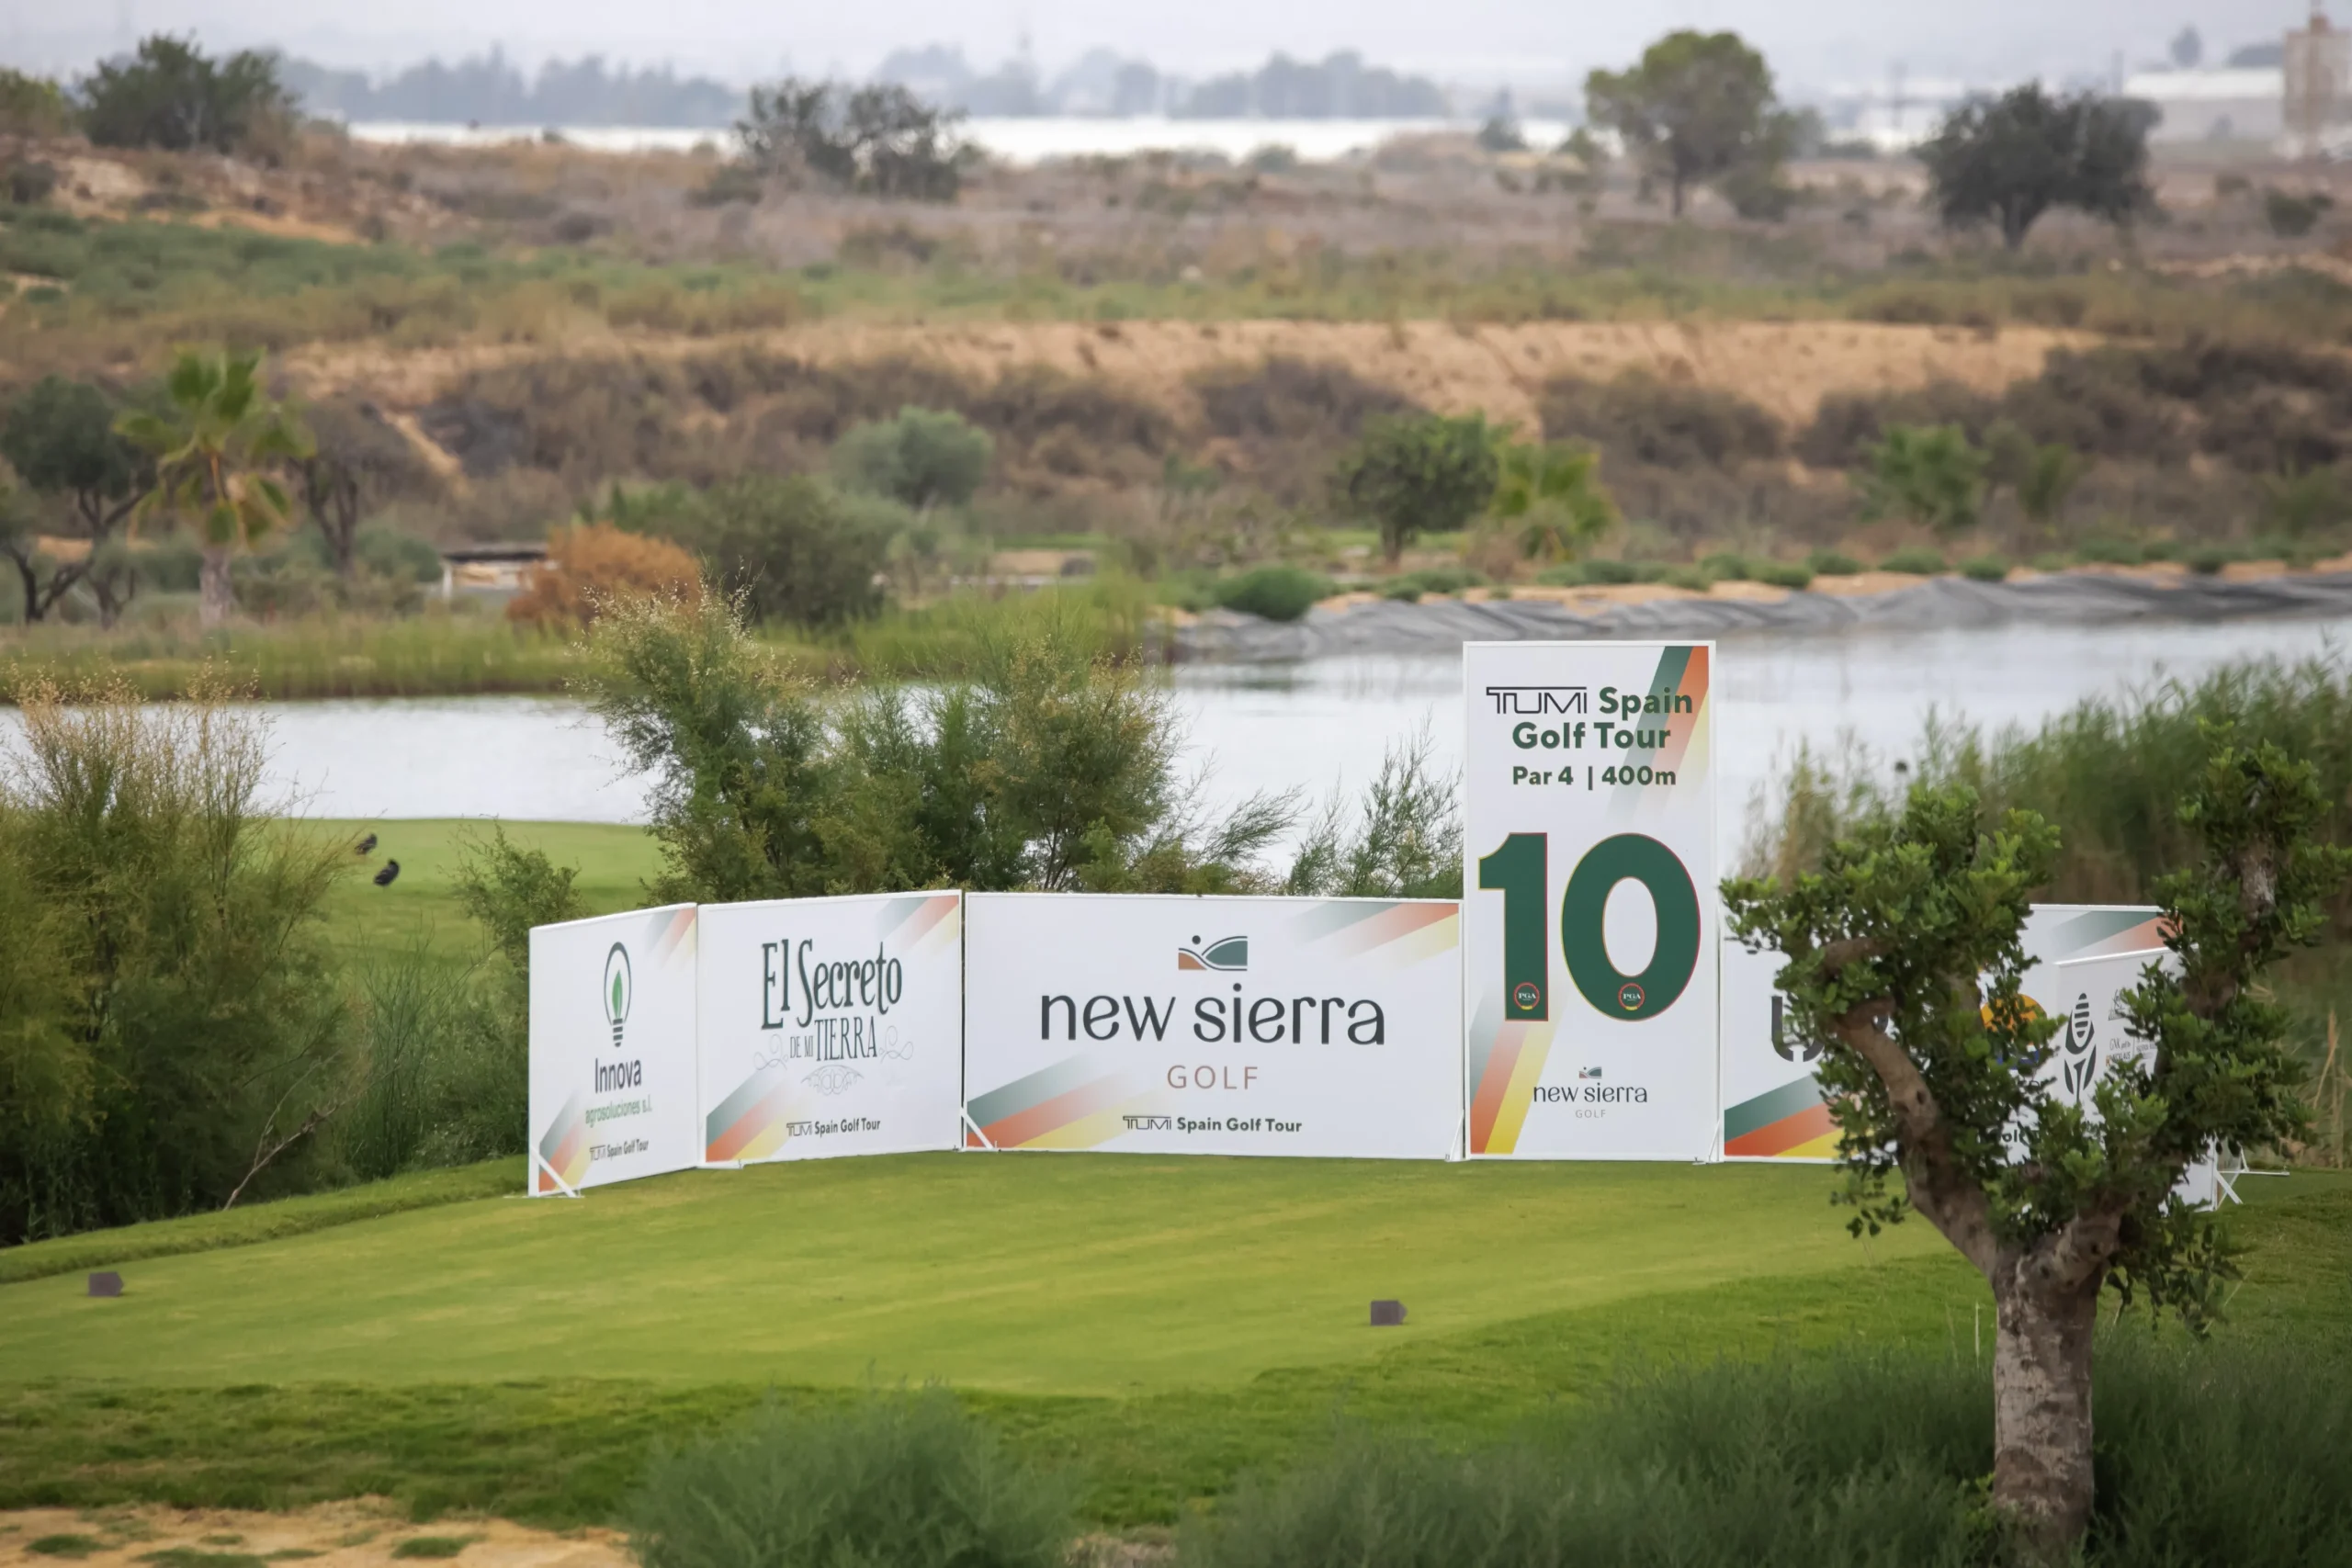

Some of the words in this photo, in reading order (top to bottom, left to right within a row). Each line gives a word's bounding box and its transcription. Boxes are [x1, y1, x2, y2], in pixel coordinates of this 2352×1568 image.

[1486, 686, 1588, 714] TUMI
[1599, 686, 1692, 721] Spain
[1512, 722, 1586, 749] Golf
[1593, 722, 1671, 749] Tour
[1512, 766, 1553, 785] Par
[1558, 766, 1574, 785] 4
[1601, 766, 1677, 785] 400m
[1477, 832, 1701, 1021] 10
[761, 939, 790, 1030] El
[797, 939, 902, 1028] Secreto
[1041, 995, 1176, 1042] new
[1194, 983, 1385, 1045] sierra
[790, 1036, 801, 1058] DE
[804, 1035, 814, 1057] MI
[815, 1016, 877, 1062] TIERRA
[595, 1057, 641, 1094] Innova
[1167, 1065, 1258, 1090] GOLF
[1533, 1087, 1578, 1102] new
[1584, 1082, 1647, 1103] sierra
[585, 1100, 640, 1128] agrosoluciones
[786, 1122, 812, 1136] TUMI
[814, 1120, 838, 1138] Spain
[841, 1118, 859, 1133] Golf
[861, 1117, 881, 1131] Tour
[1123, 1115, 1171, 1130] TUMI
[1177, 1117, 1221, 1134] Spain
[1227, 1118, 1261, 1132] Golf
[1265, 1118, 1302, 1132] Tour
[1576, 1109, 1606, 1119] GOLF
[607, 1143, 622, 1161] Spain
[624, 1140, 635, 1155] Golf
[636, 1138, 649, 1152] Tour
